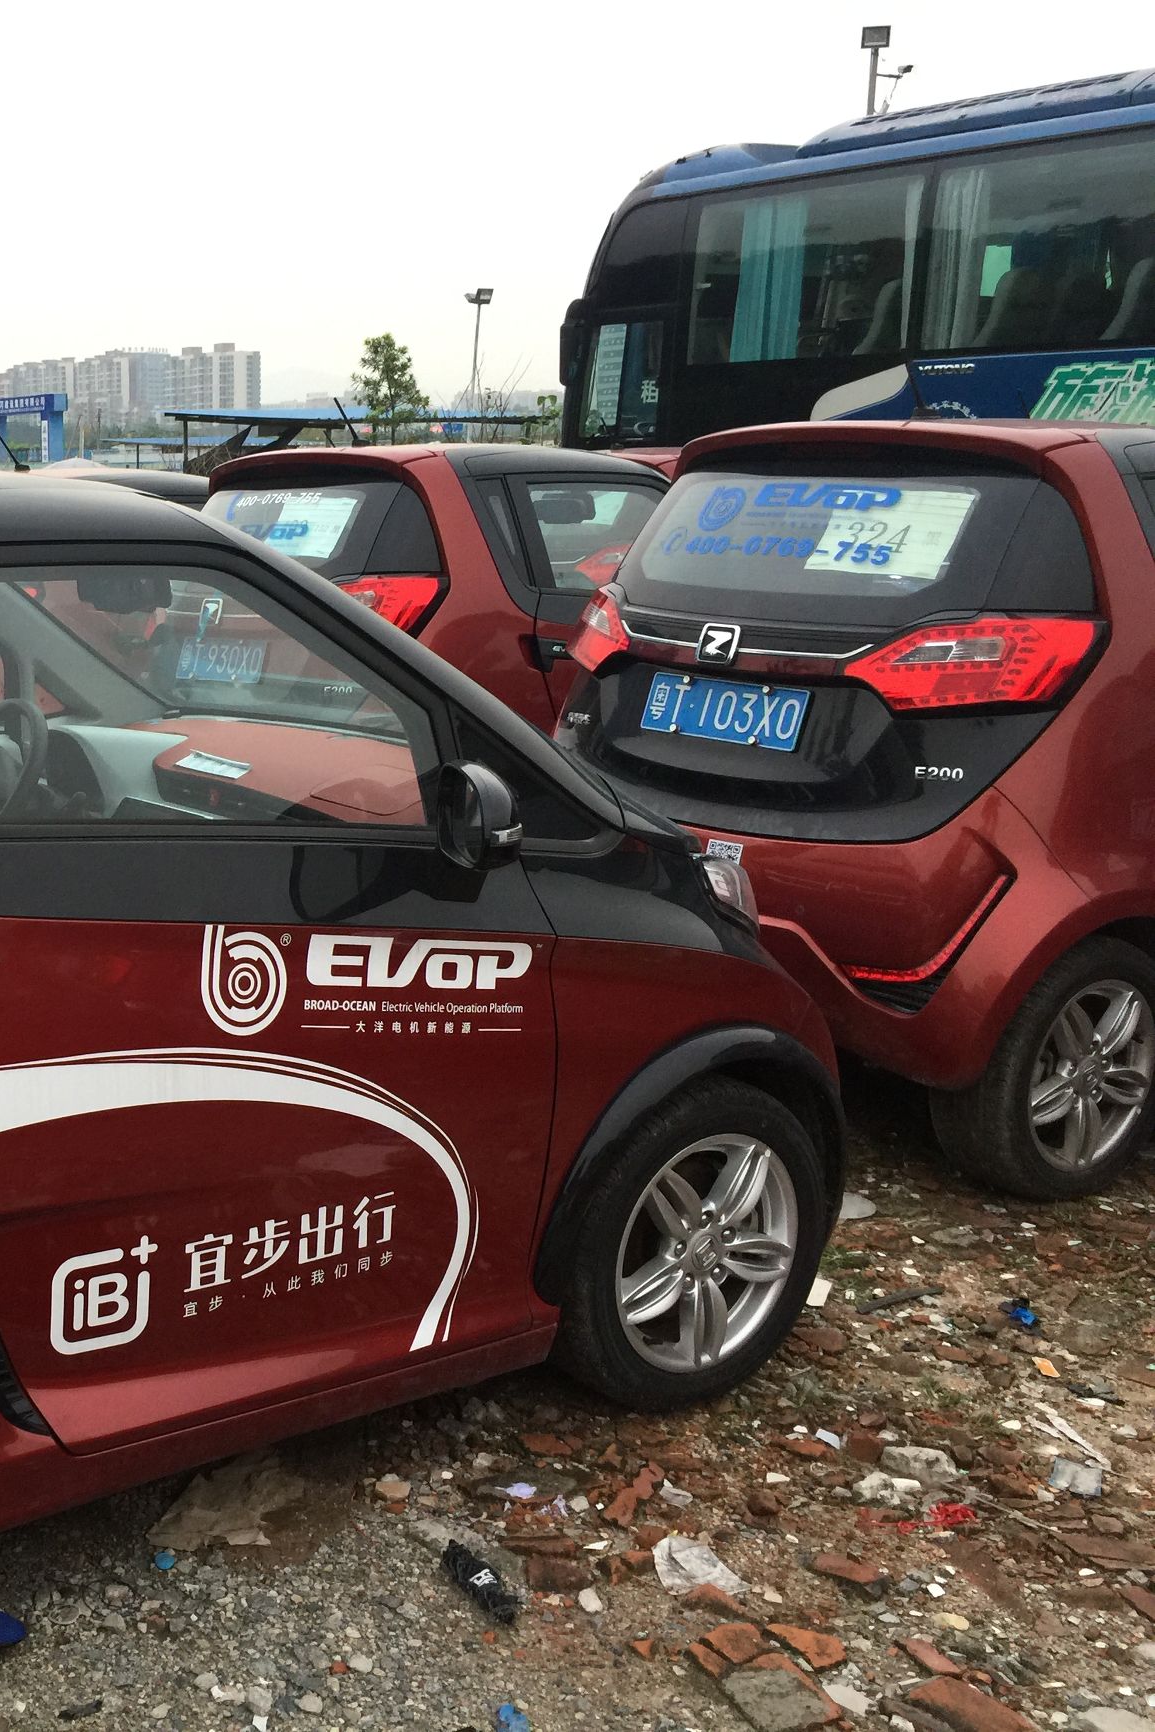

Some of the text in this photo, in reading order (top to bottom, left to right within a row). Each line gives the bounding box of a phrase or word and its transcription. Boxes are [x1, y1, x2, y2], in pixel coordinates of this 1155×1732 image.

[918, 363, 975, 376] YUTONG
[236, 492, 323, 508] 400-0769-755
[846, 521, 912, 553] 324
[685, 535, 894, 566] 400-0769-755
[915, 765, 964, 783] E200
[304, 1000, 523, 1015] BROAD-OCEAN Electric Vehicle Operation Platform
[356, 1021, 472, 1034] 大洋电机新能源
[183, 1191, 397, 1293] 宜步出行
